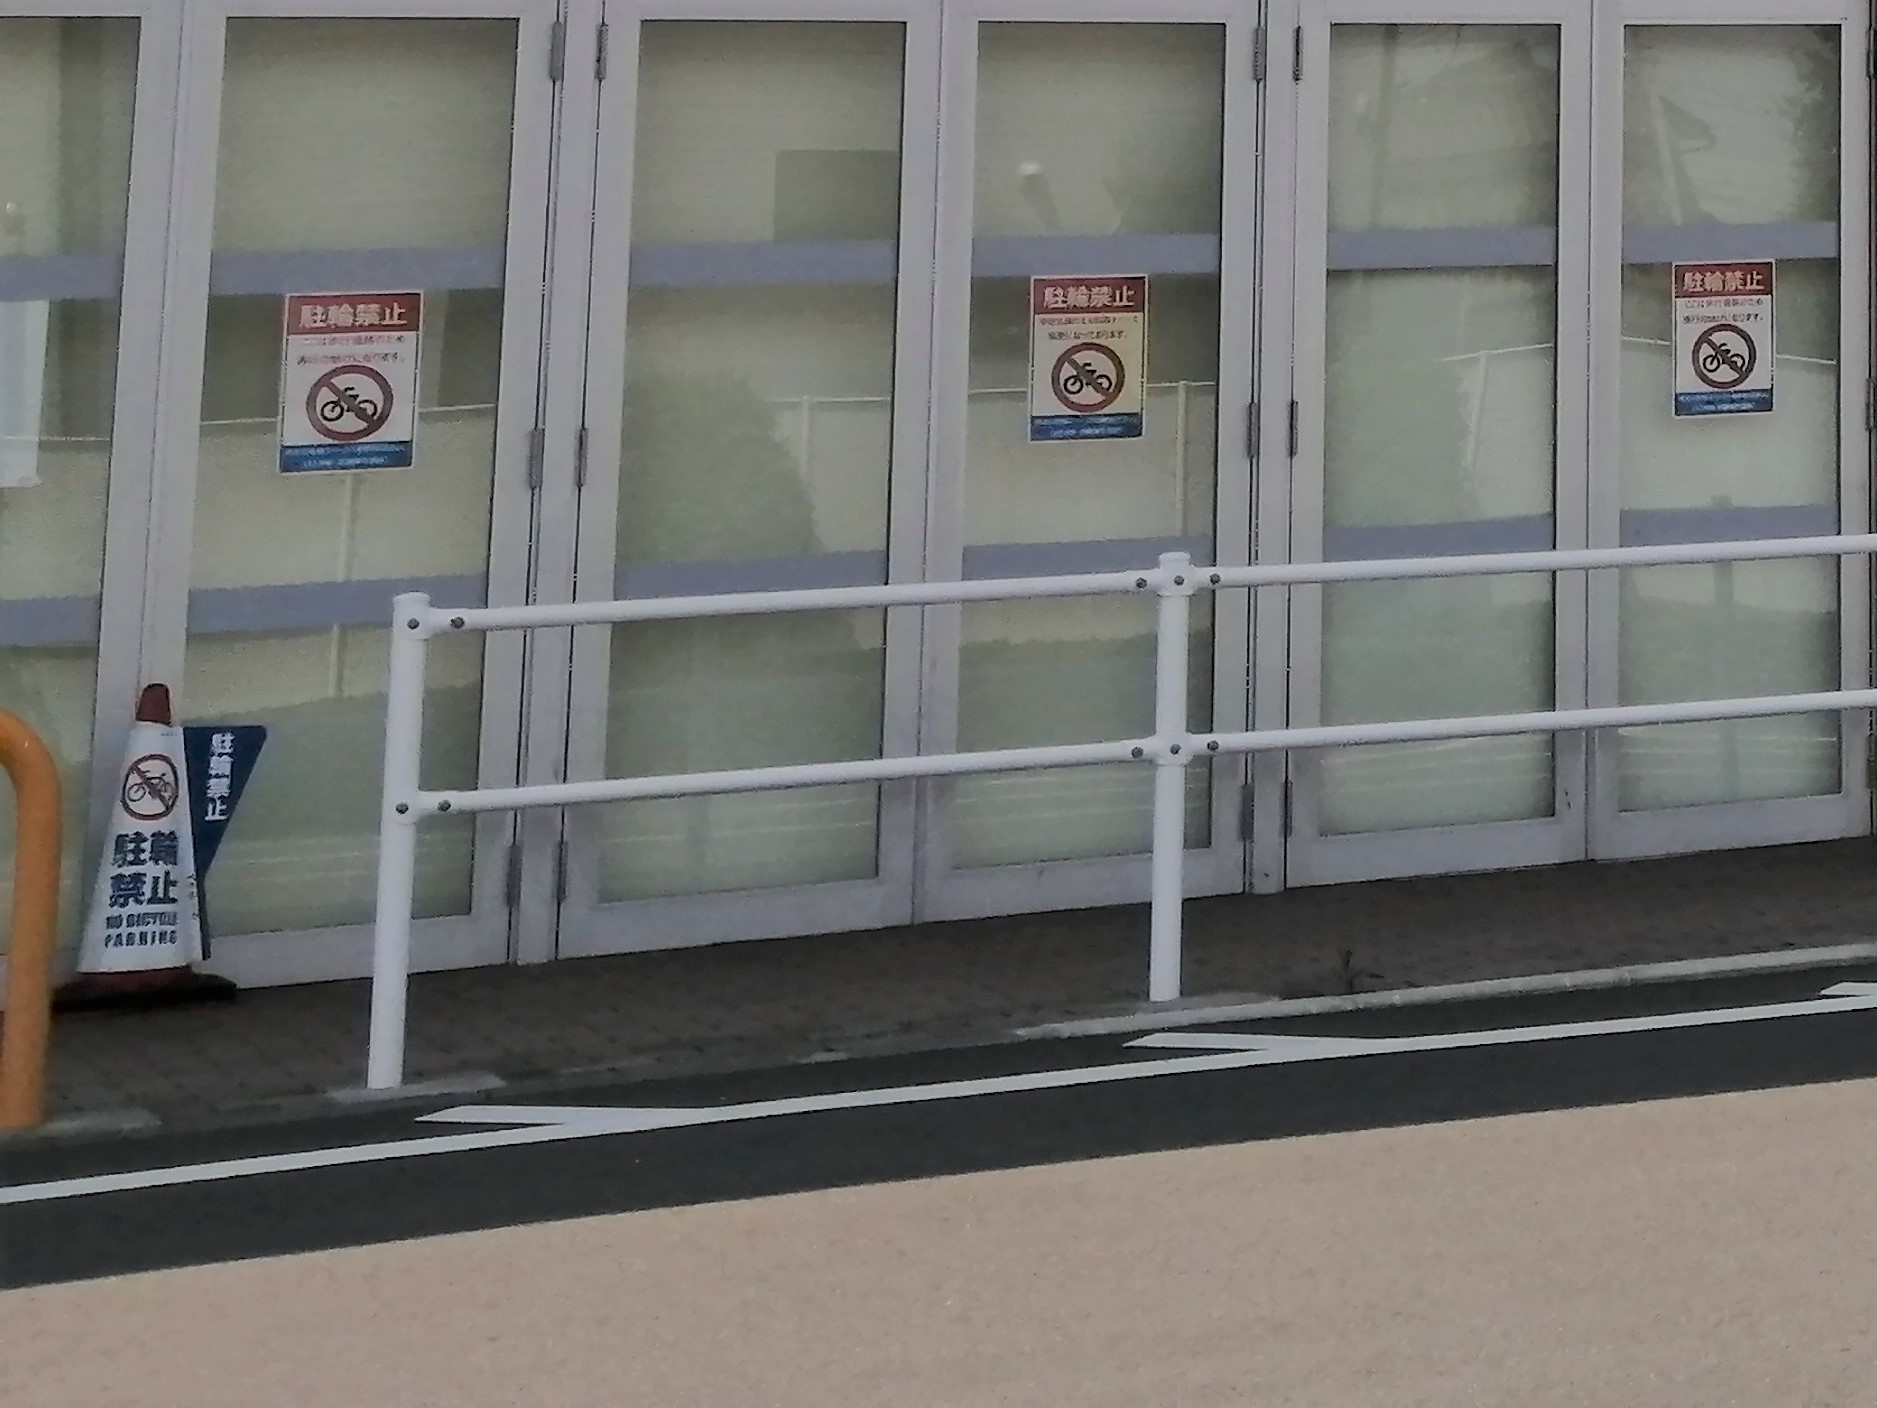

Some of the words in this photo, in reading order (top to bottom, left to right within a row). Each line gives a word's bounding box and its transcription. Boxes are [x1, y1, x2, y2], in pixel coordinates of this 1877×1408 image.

[1684, 270, 1765, 292] 駐輪禁止
[1044, 285, 1135, 309] 駐輪禁止
[300, 302, 408, 329] 駐輪禁止
[110, 830, 179, 868] 駐輪
[108, 869, 179, 908] 禁止
